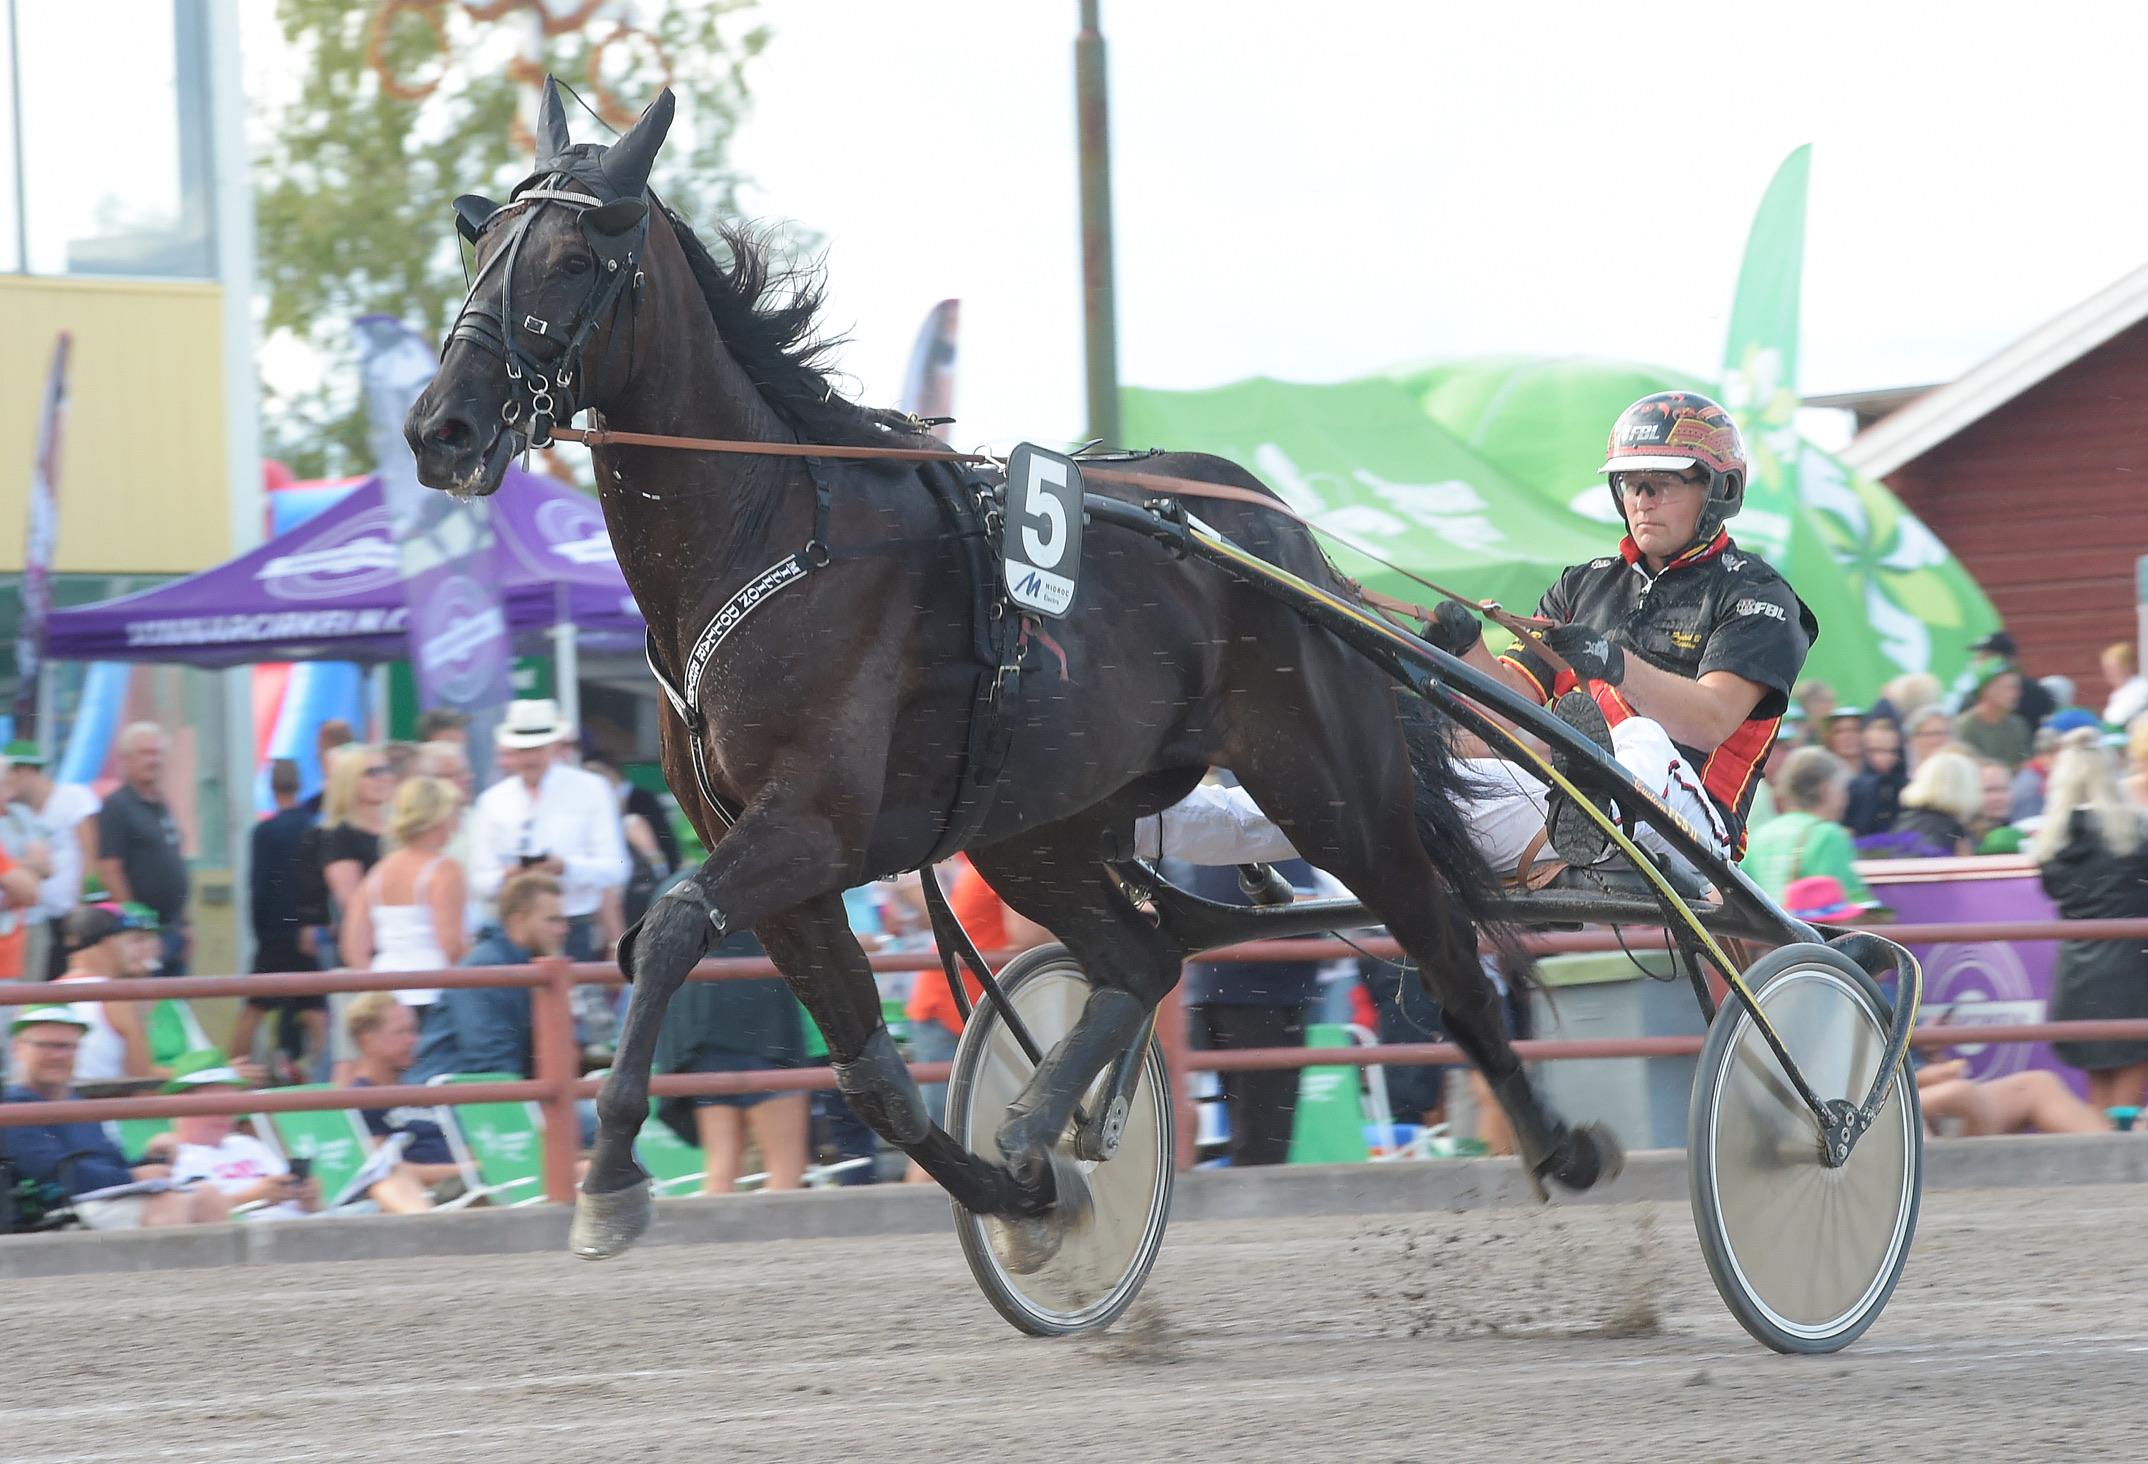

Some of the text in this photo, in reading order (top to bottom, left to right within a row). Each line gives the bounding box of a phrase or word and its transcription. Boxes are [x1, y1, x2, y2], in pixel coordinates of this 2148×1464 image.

[1628, 425, 1660, 440] FBL
[1022, 453, 1067, 569] 5
[738, 561, 801, 607] MILLION
[1045, 583, 1069, 598] MIDROC
[695, 605, 740, 661] DOLLAR
[1753, 601, 1787, 622] FBL
[1634, 779, 1669, 815] Custom
[1667, 806, 1689, 832] FCS
